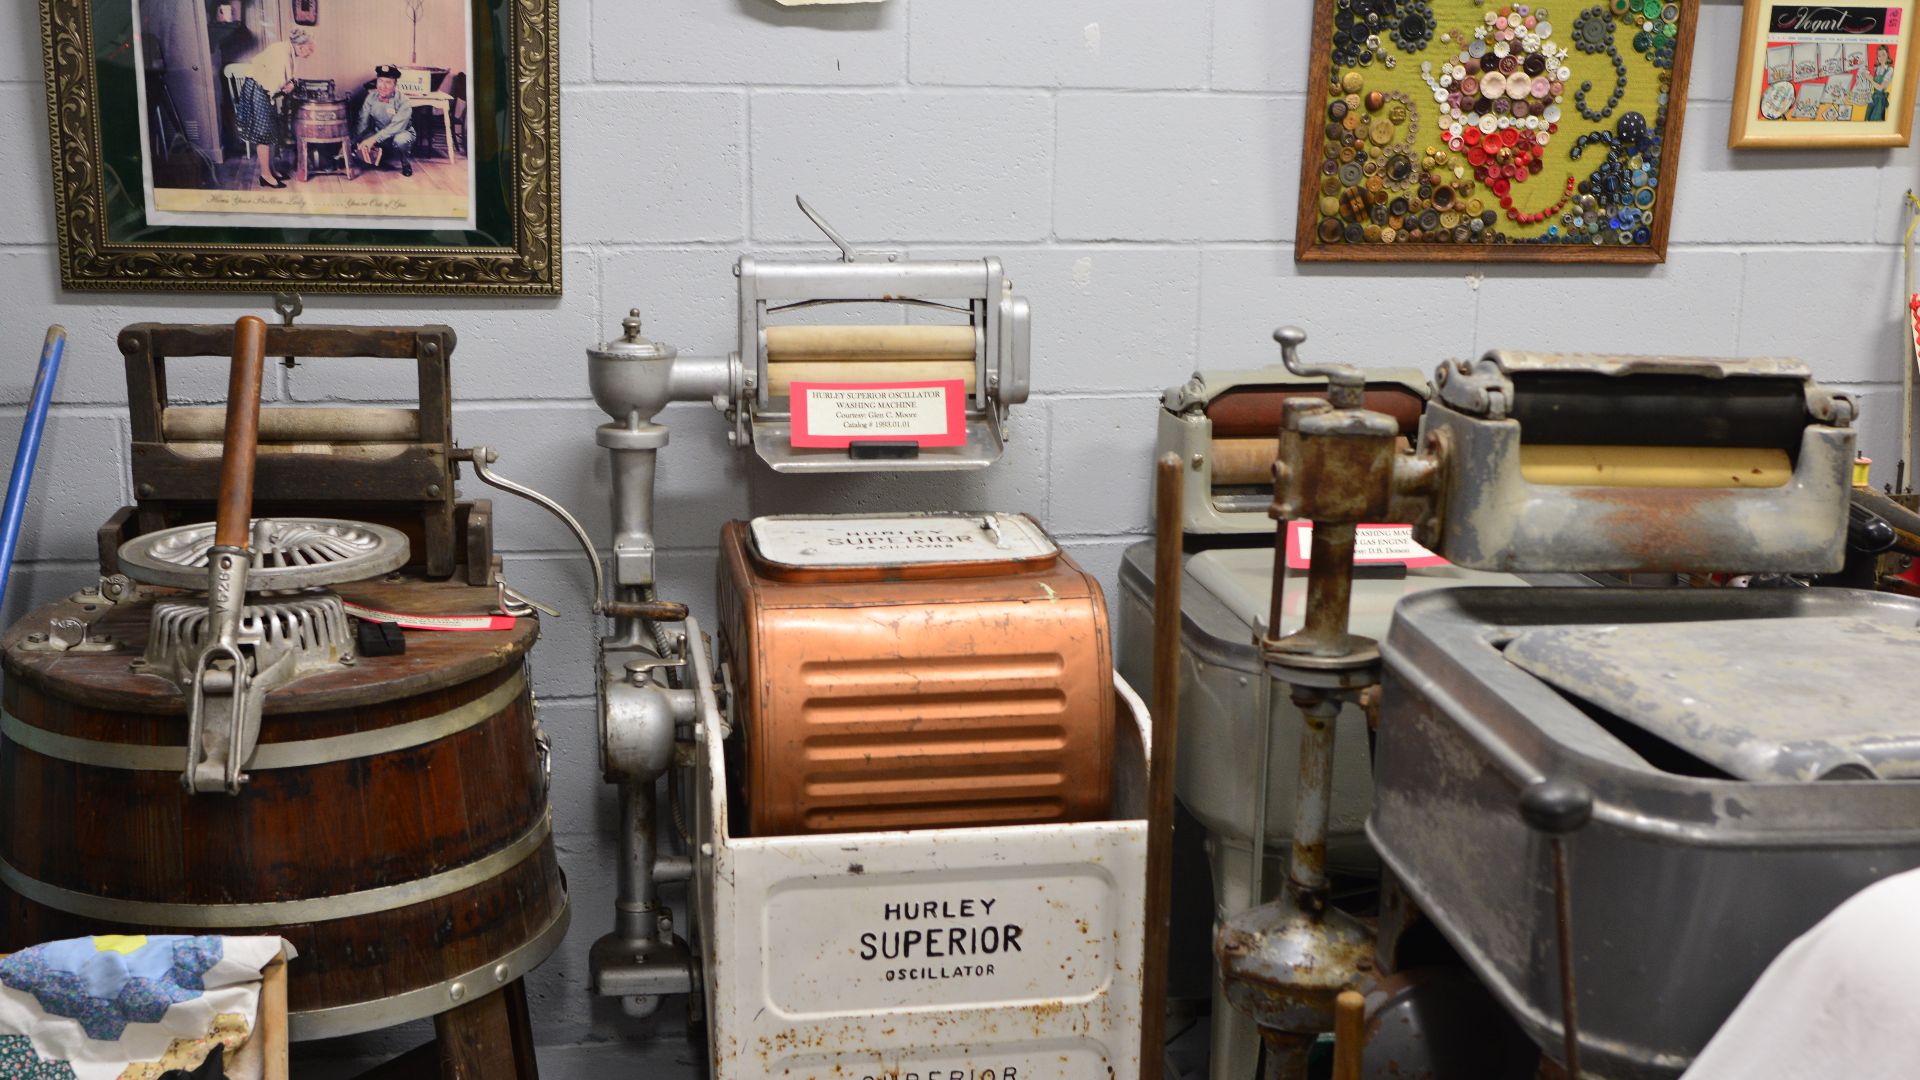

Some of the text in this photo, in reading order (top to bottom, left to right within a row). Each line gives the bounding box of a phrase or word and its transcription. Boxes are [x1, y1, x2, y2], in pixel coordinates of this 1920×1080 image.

[1778, 7, 1853, 33] Vogart
[812, 390, 941, 399] HURLEY SUPERIOR OSCILLATOR
[835, 411, 866, 420] Courtesy:
[868, 411, 884, 419] Glen
[843, 421, 868, 430] Catalog
[828, 535, 975, 546] SUPERIOR
[884, 899, 996, 921] HURLEY
[860, 924, 1024, 960] SUPERIOR
[886, 964, 995, 981] OSCILLATOR
